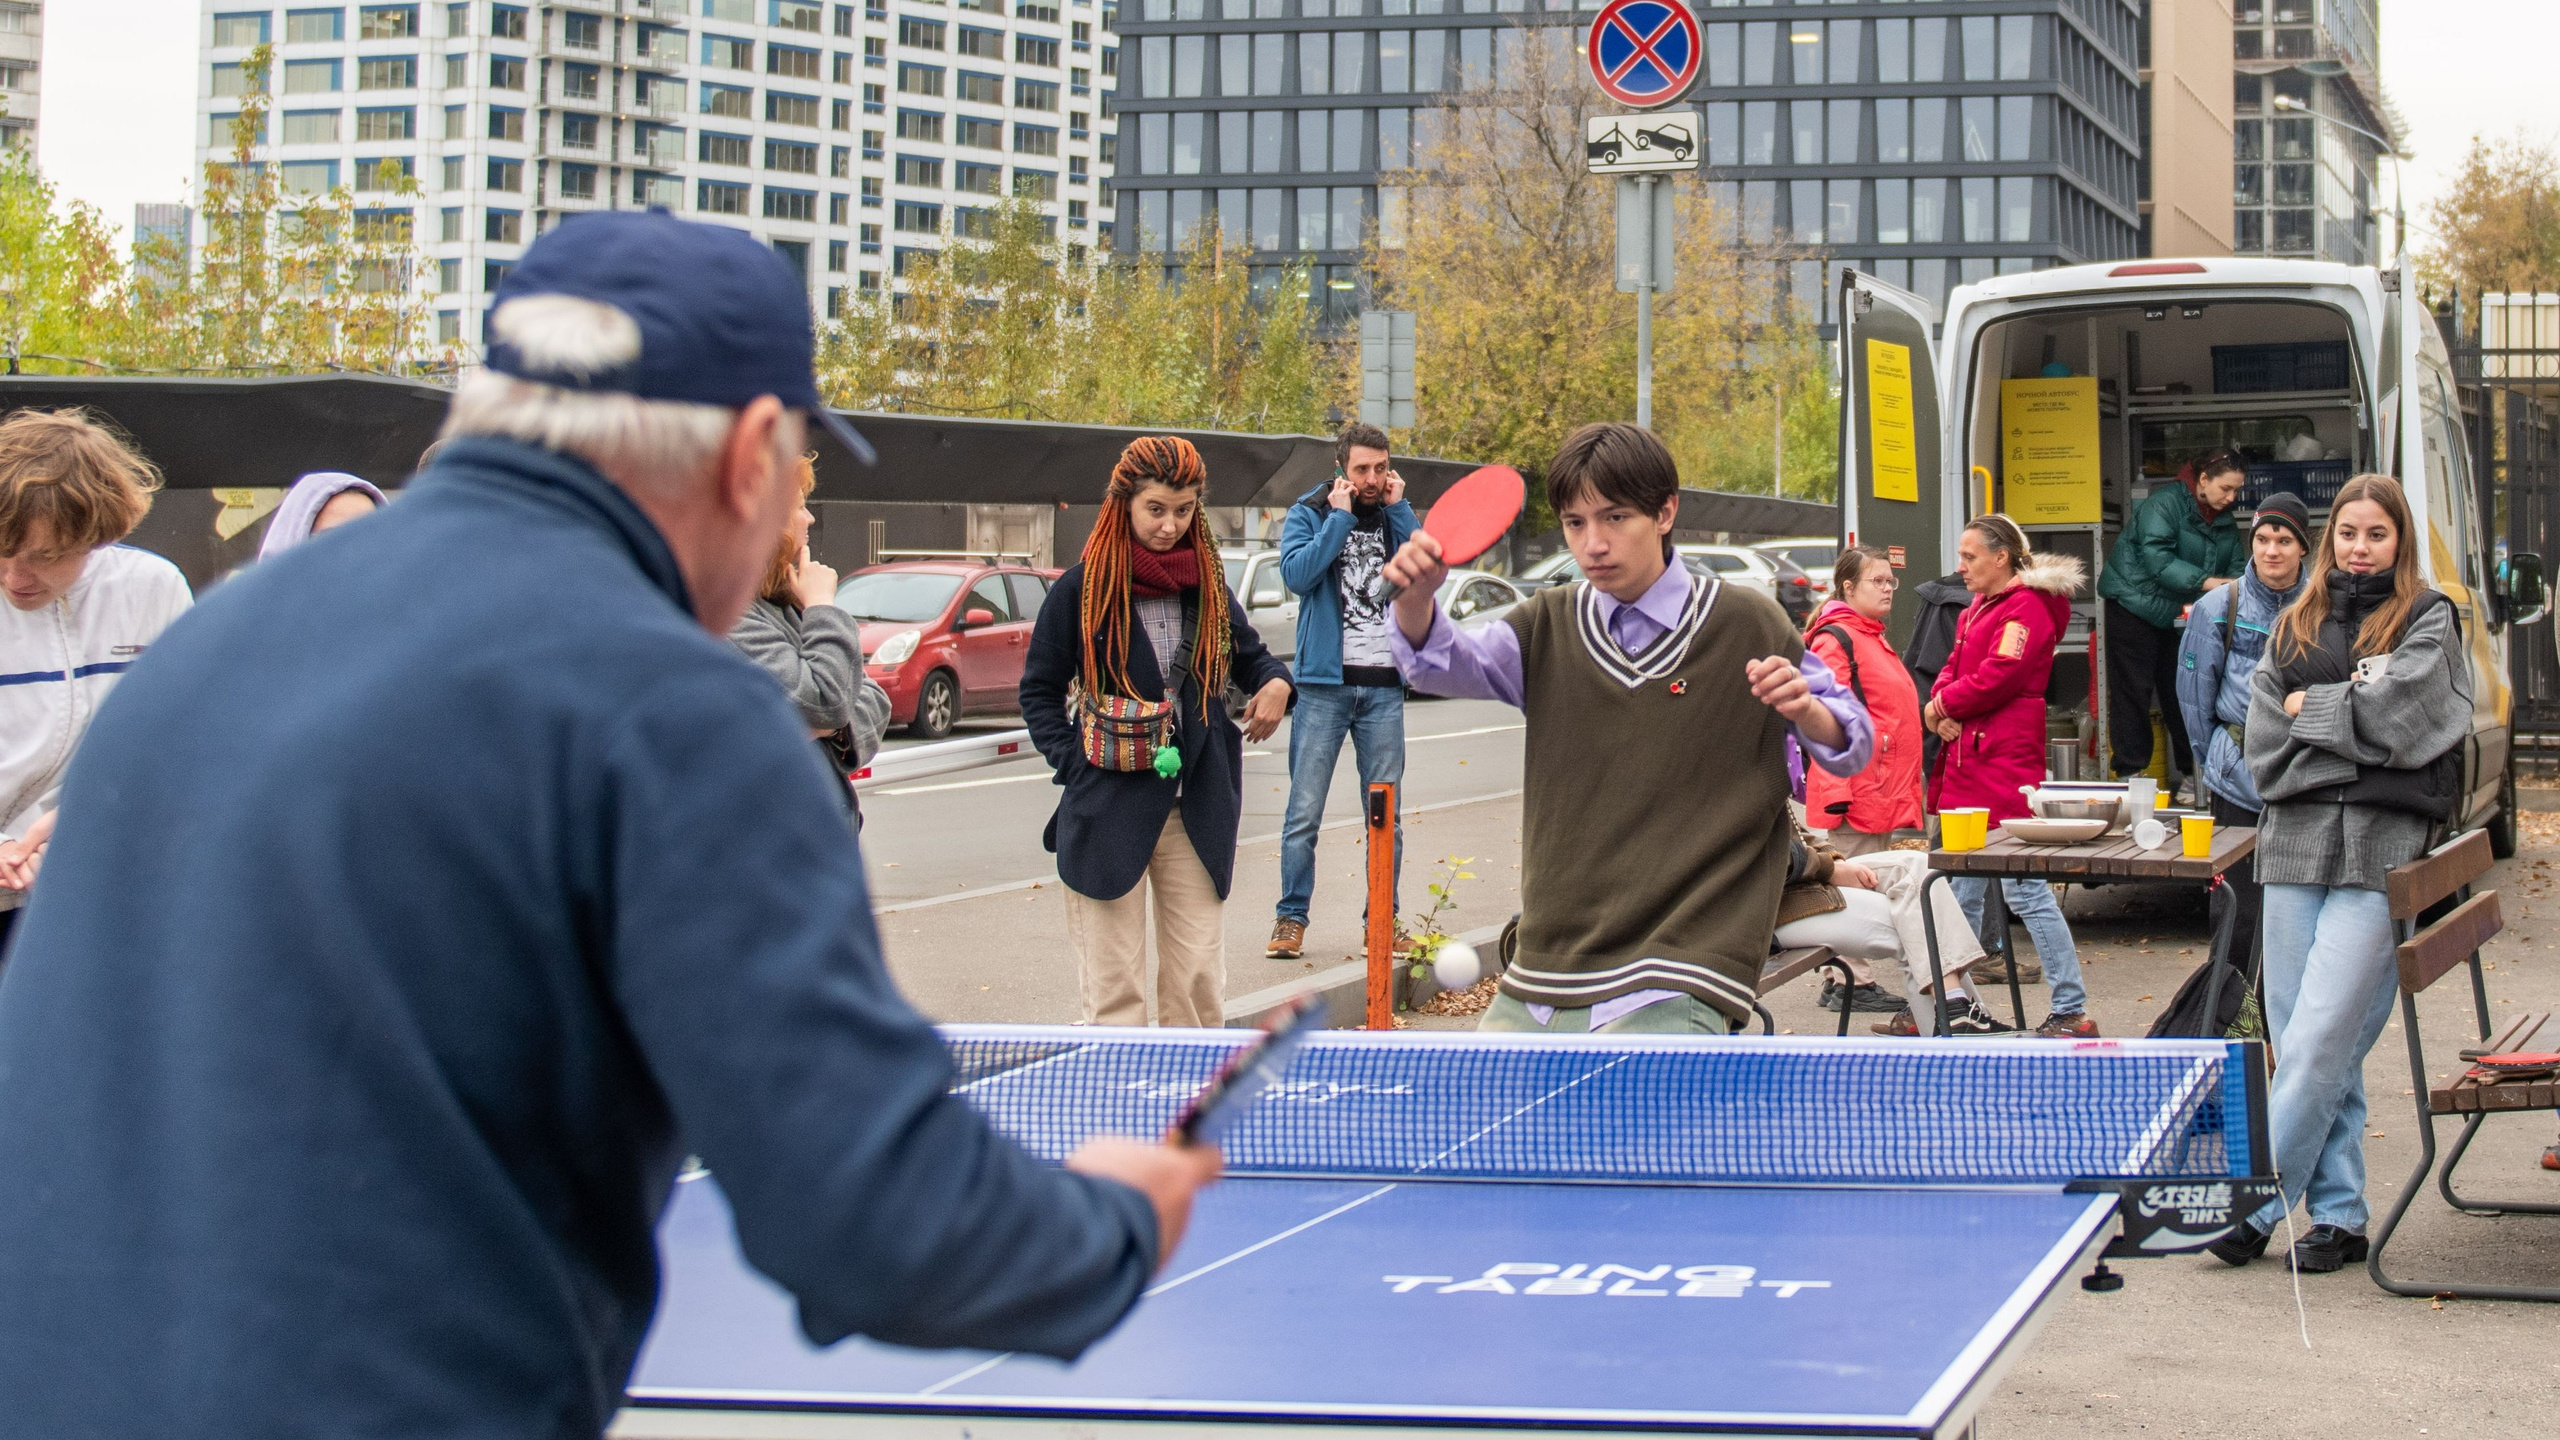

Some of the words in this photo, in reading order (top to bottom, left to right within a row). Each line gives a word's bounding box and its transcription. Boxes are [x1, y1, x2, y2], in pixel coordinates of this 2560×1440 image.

[2048, 390, 2080, 398] АВТОБУС
[2180, 1208, 2232, 1224] DHS
[1482, 1262, 1757, 1282] PING
[1382, 1275, 1832, 1298] TABLET
